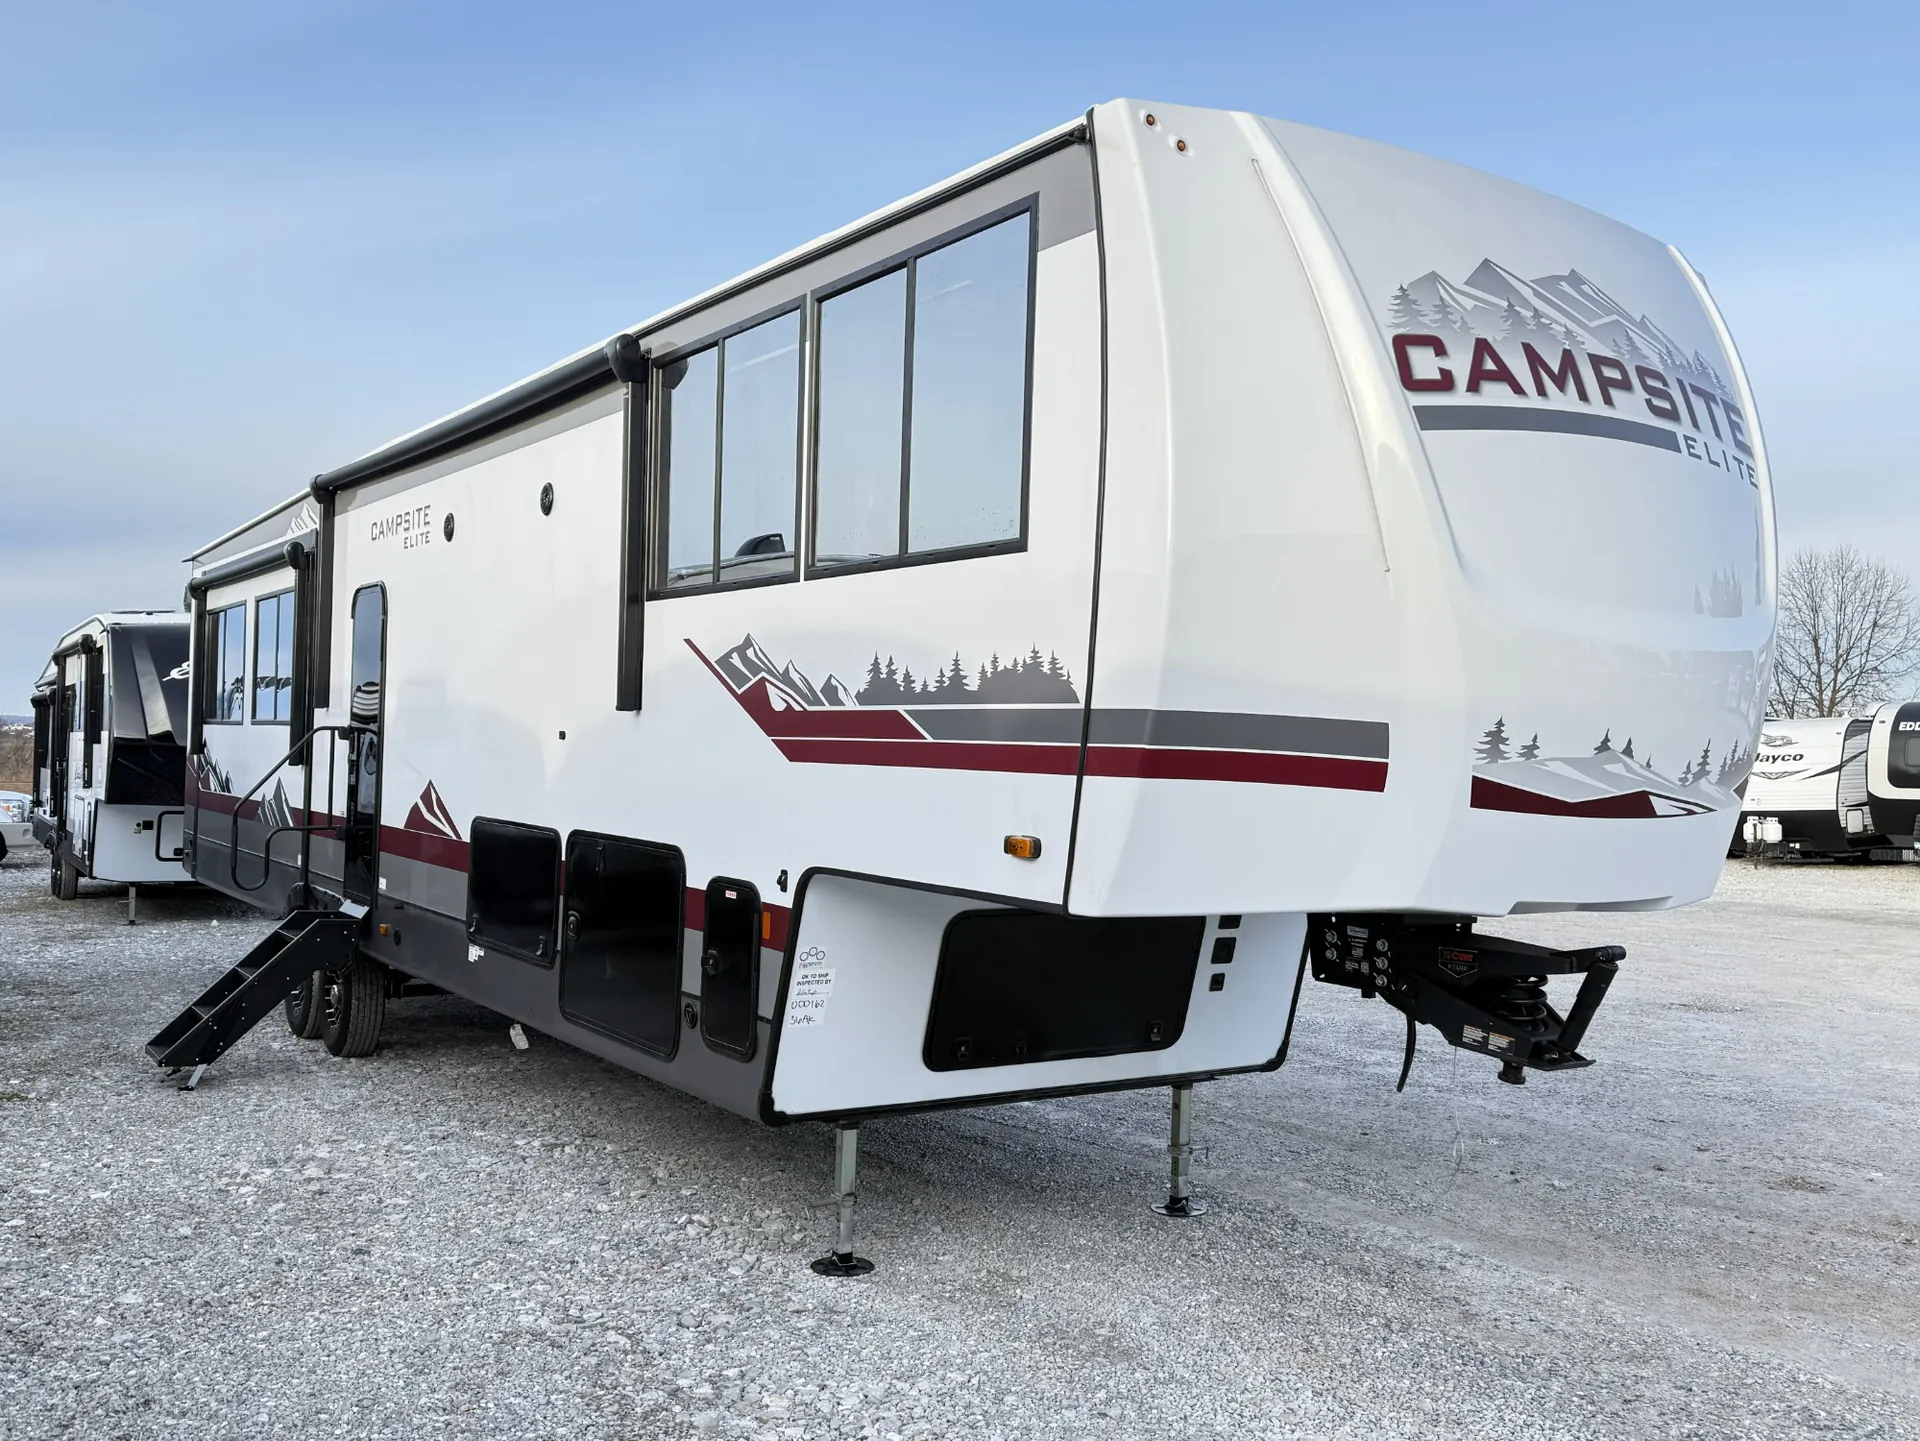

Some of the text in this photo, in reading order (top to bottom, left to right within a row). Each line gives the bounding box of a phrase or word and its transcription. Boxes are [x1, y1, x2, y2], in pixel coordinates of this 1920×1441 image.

[1392, 333, 1754, 460] CAMPSITE
[1682, 433, 1759, 490] ELITE
[371, 504, 431, 541] CAMPSITE
[403, 531, 430, 549] ELITE
